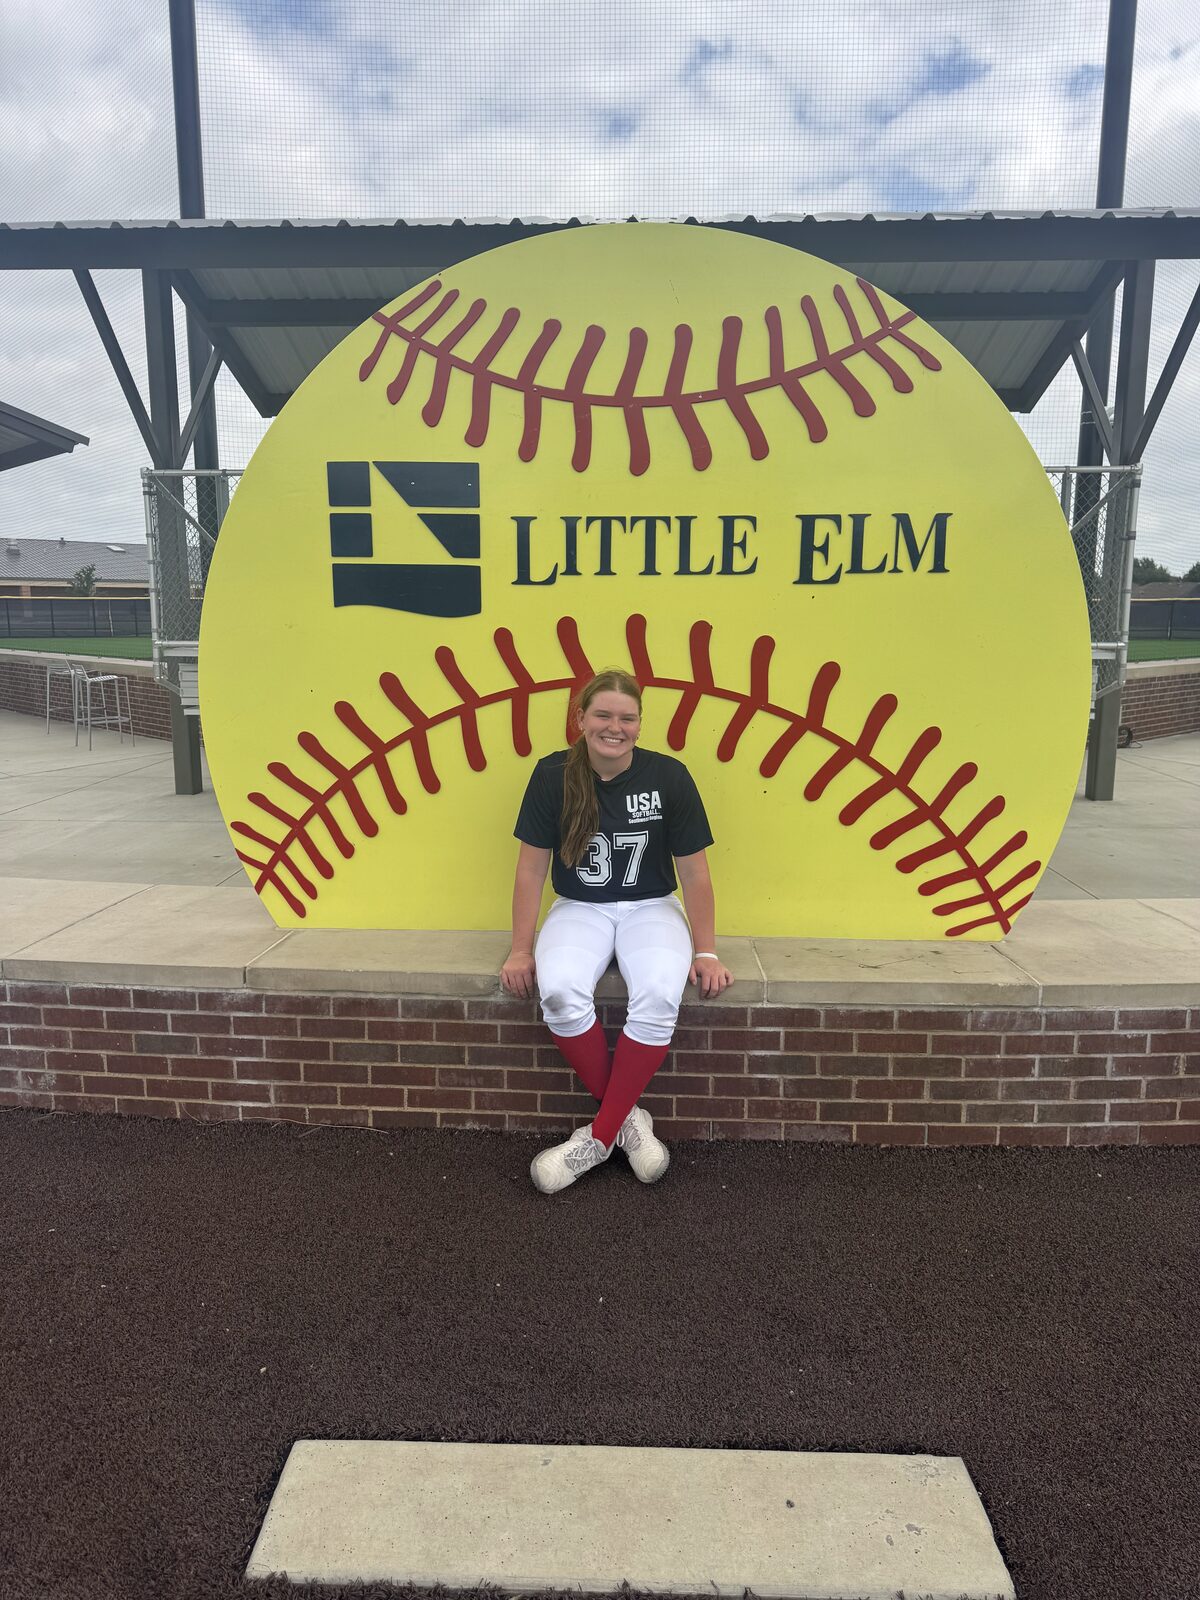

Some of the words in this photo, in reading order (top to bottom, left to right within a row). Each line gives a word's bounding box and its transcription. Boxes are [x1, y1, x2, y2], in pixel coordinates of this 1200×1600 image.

[511, 515, 758, 585] LITTLE
[793, 513, 953, 585] ELM
[626, 790, 662, 812] USA
[632, 808, 659, 818] SOFTBALL
[576, 831, 649, 887] 37
